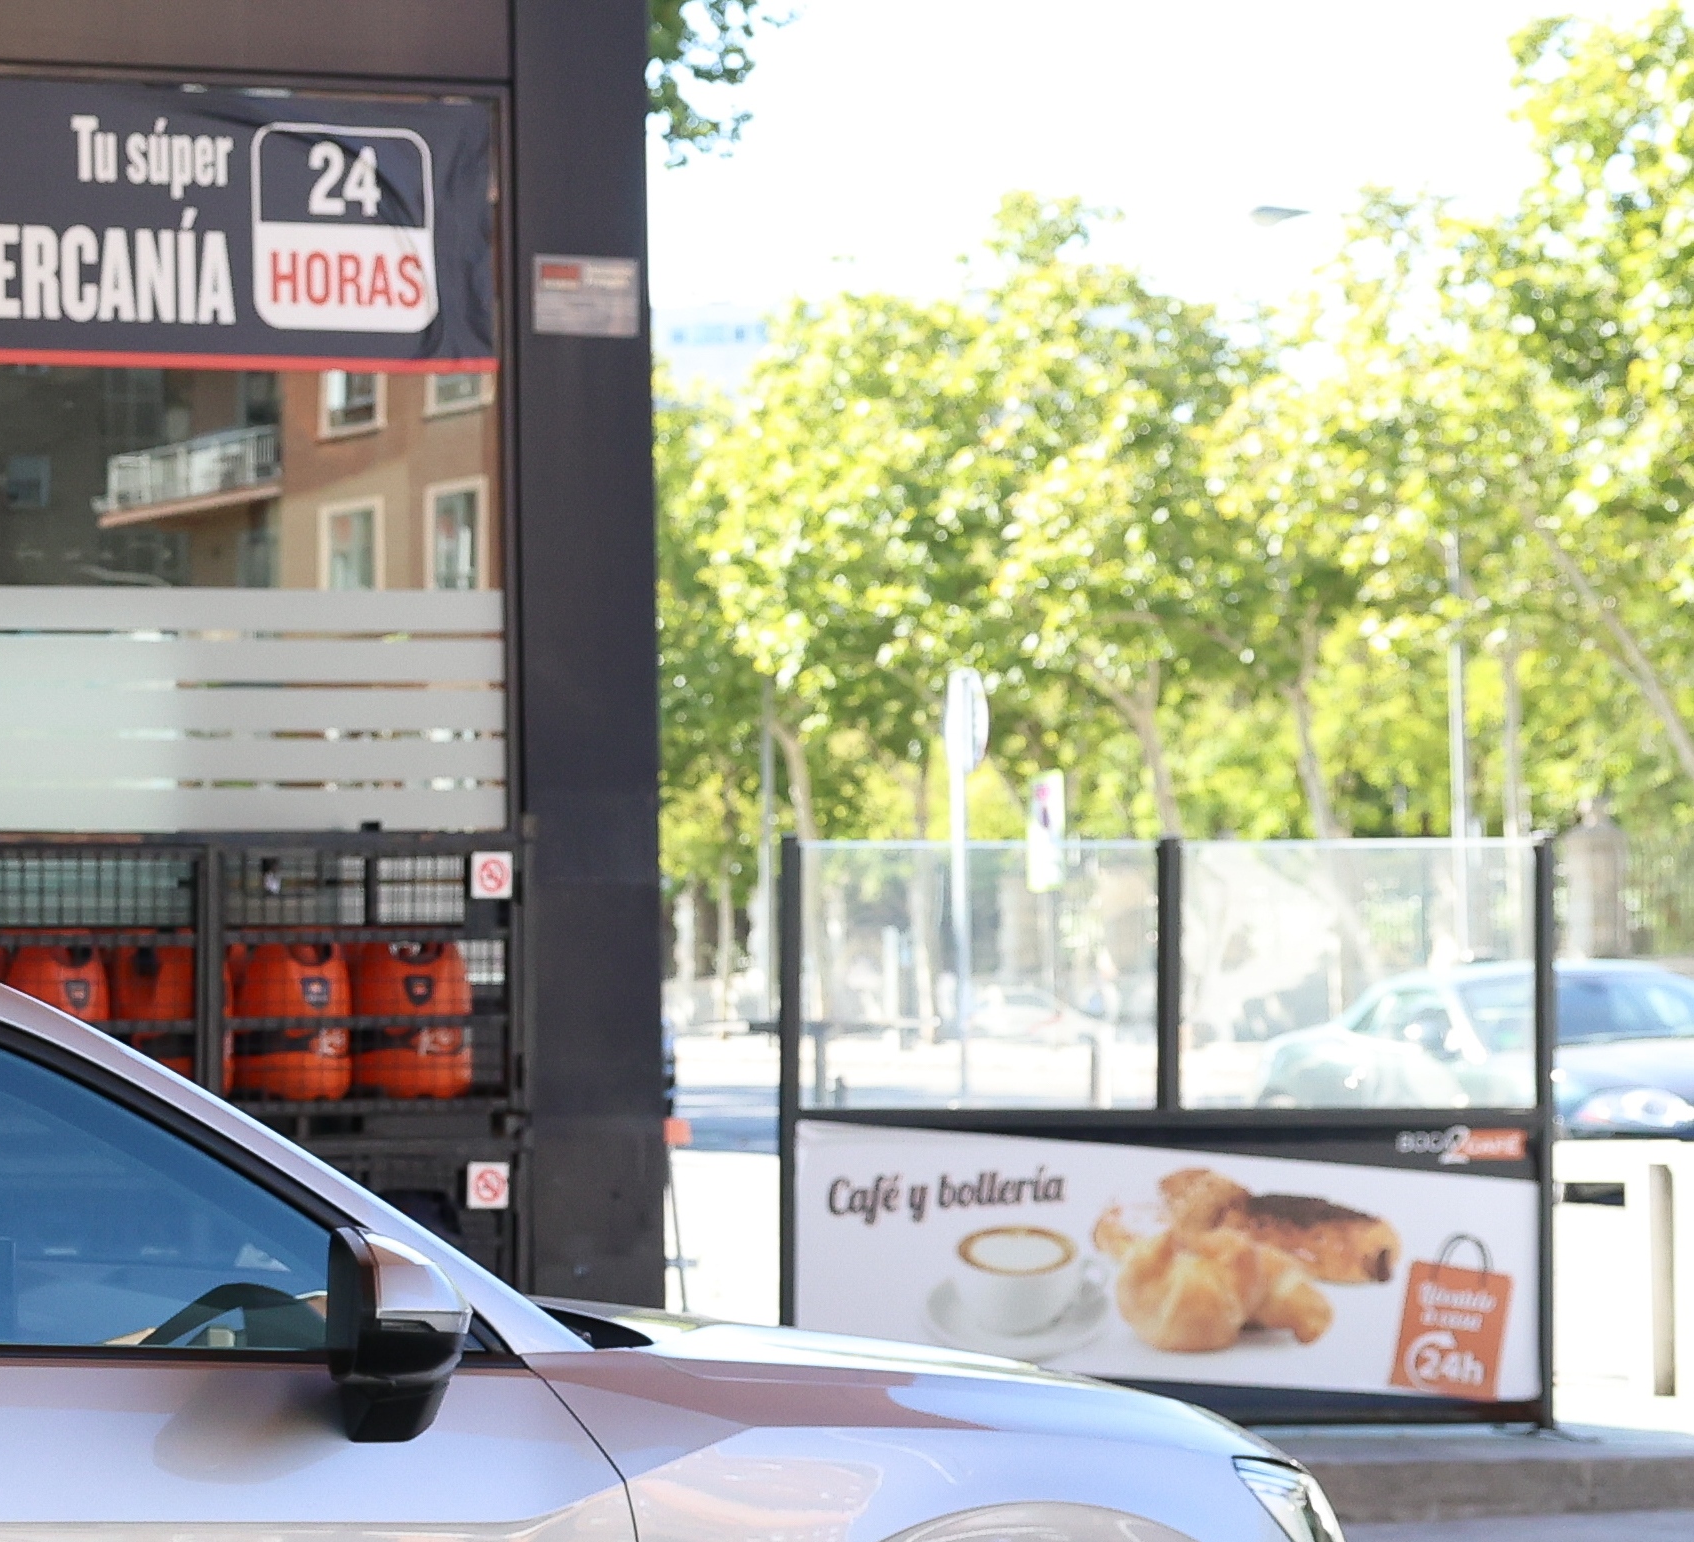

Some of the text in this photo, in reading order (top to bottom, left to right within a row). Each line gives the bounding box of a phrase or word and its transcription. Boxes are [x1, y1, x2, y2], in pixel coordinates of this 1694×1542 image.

[70, 115, 233, 198] Tu súper
[307, 141, 382, 217] 24
[269, 250, 425, 308] HORAS
[829, 1164, 1067, 1226] Café y bollería
[1414, 1349, 1485, 1387] 24h
